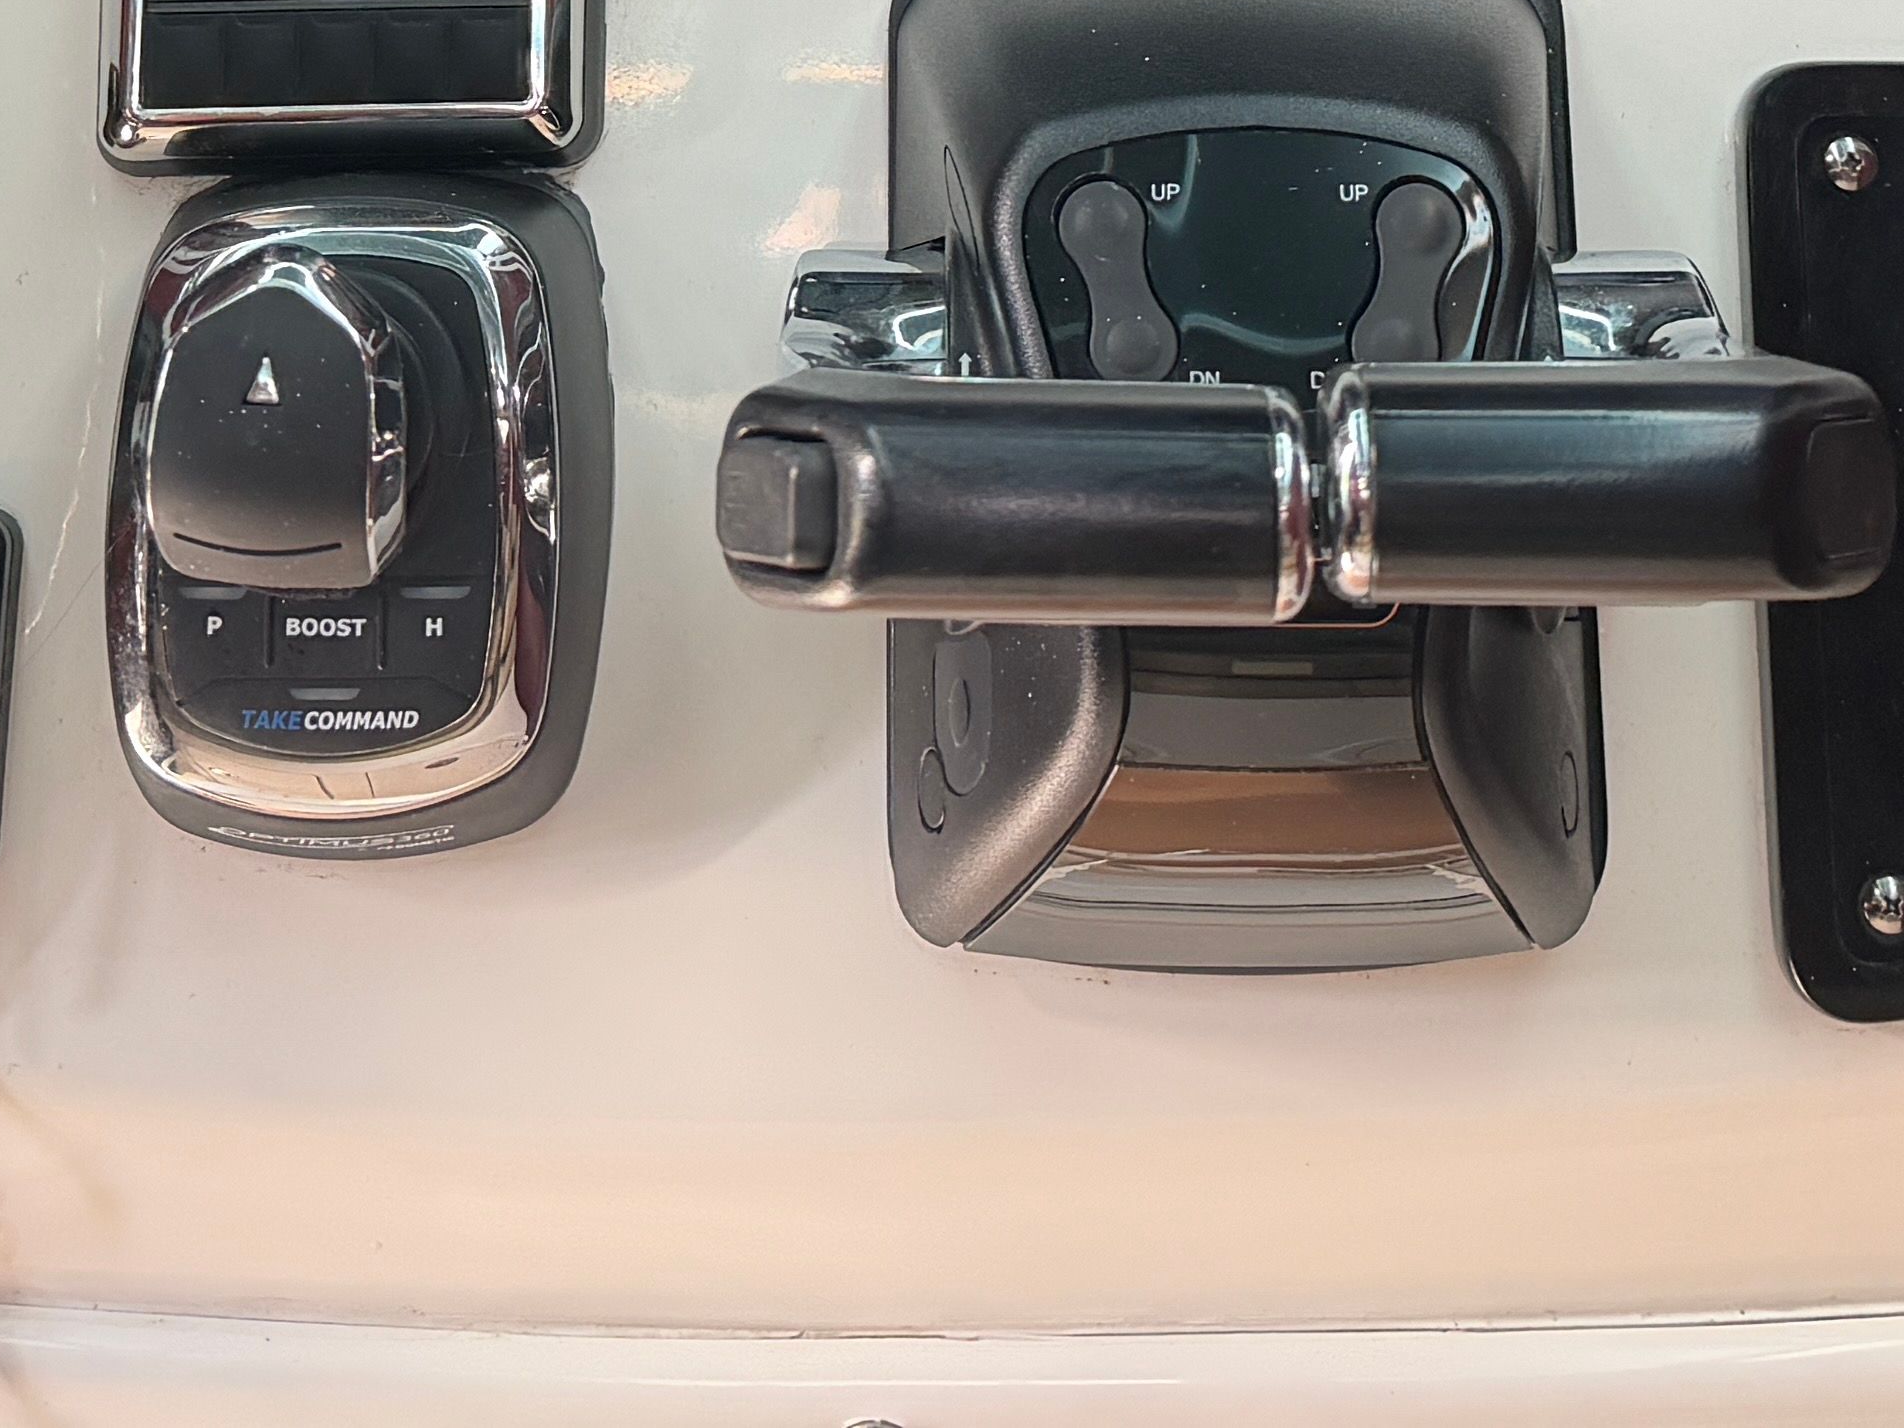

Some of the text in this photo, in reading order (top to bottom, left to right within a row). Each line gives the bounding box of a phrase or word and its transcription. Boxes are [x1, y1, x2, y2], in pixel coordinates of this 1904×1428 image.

[1151, 184, 1181, 201] UP
[1339, 184, 1369, 202] UP
[206, 616, 223, 635] P
[285, 617, 367, 637] BOOST
[425, 617, 443, 637] H
